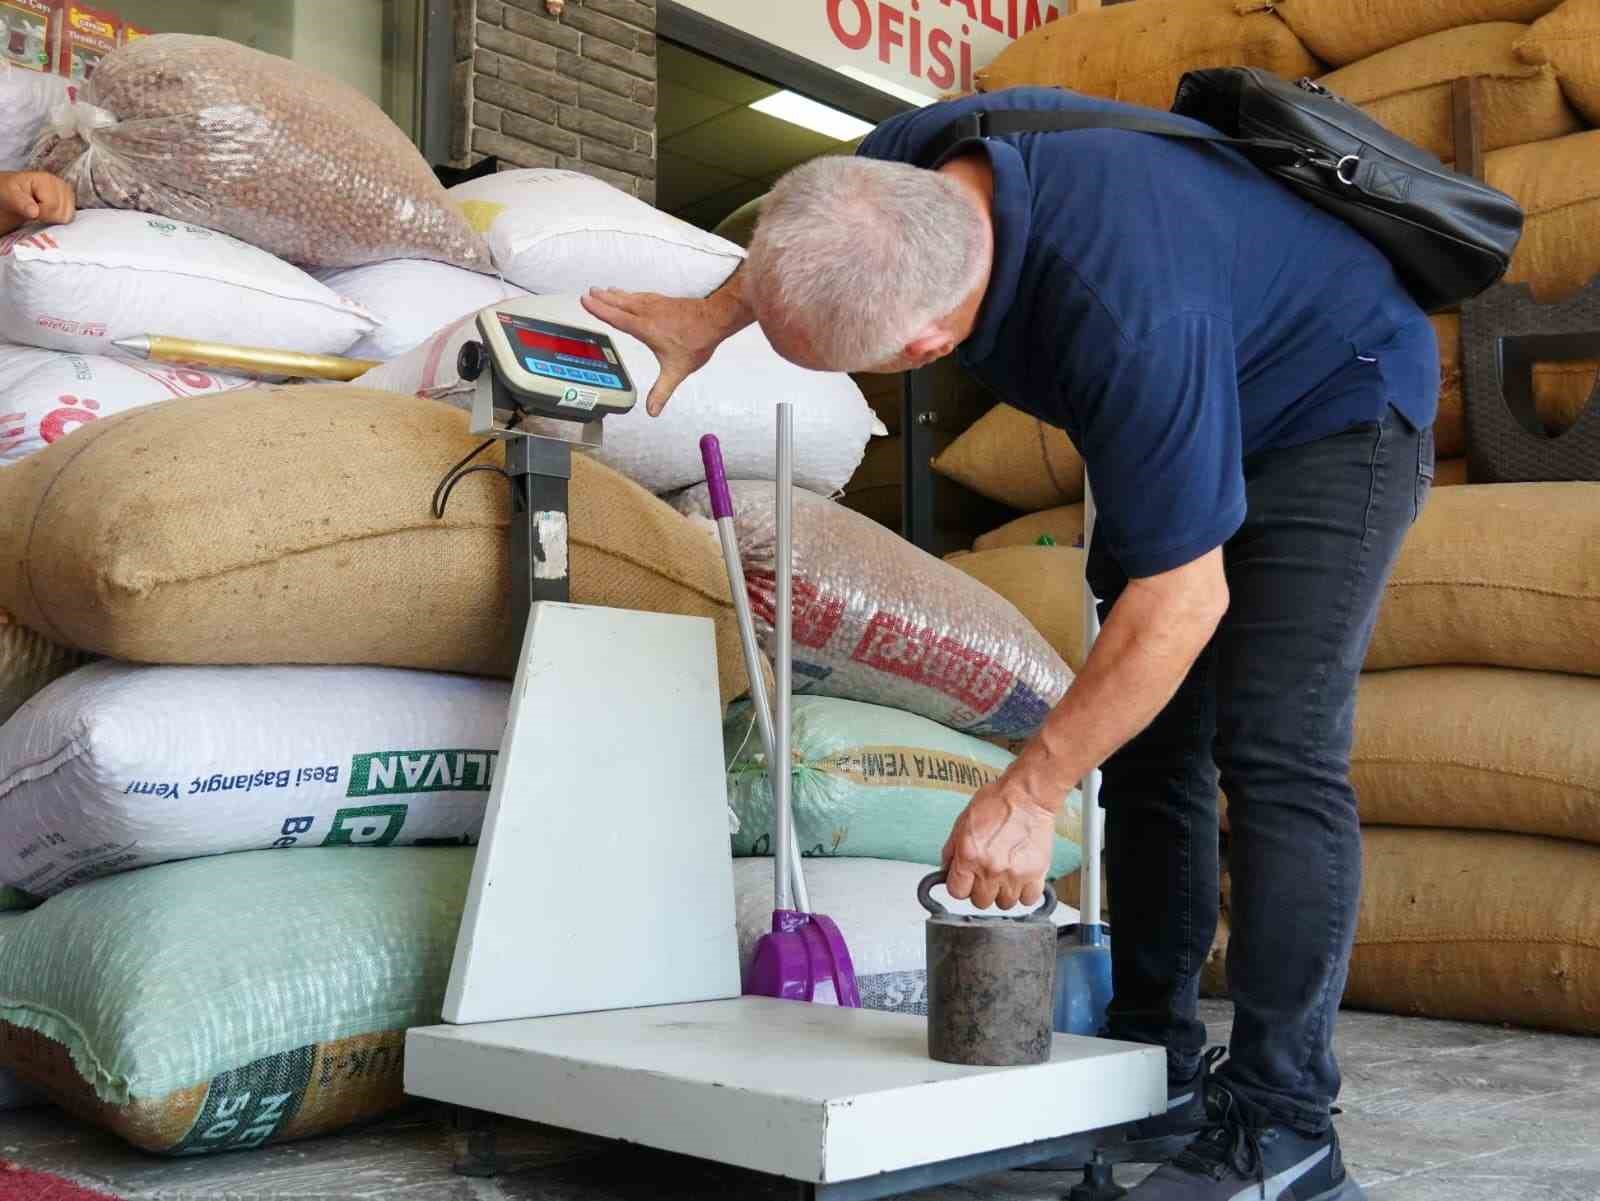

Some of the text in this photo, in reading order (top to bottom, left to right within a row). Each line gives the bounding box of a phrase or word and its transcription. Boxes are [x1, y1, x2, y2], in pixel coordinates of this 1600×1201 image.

[123, 766, 338, 800] Besi Başlangıç Yemi
[862, 753, 909, 782] YEMİ
